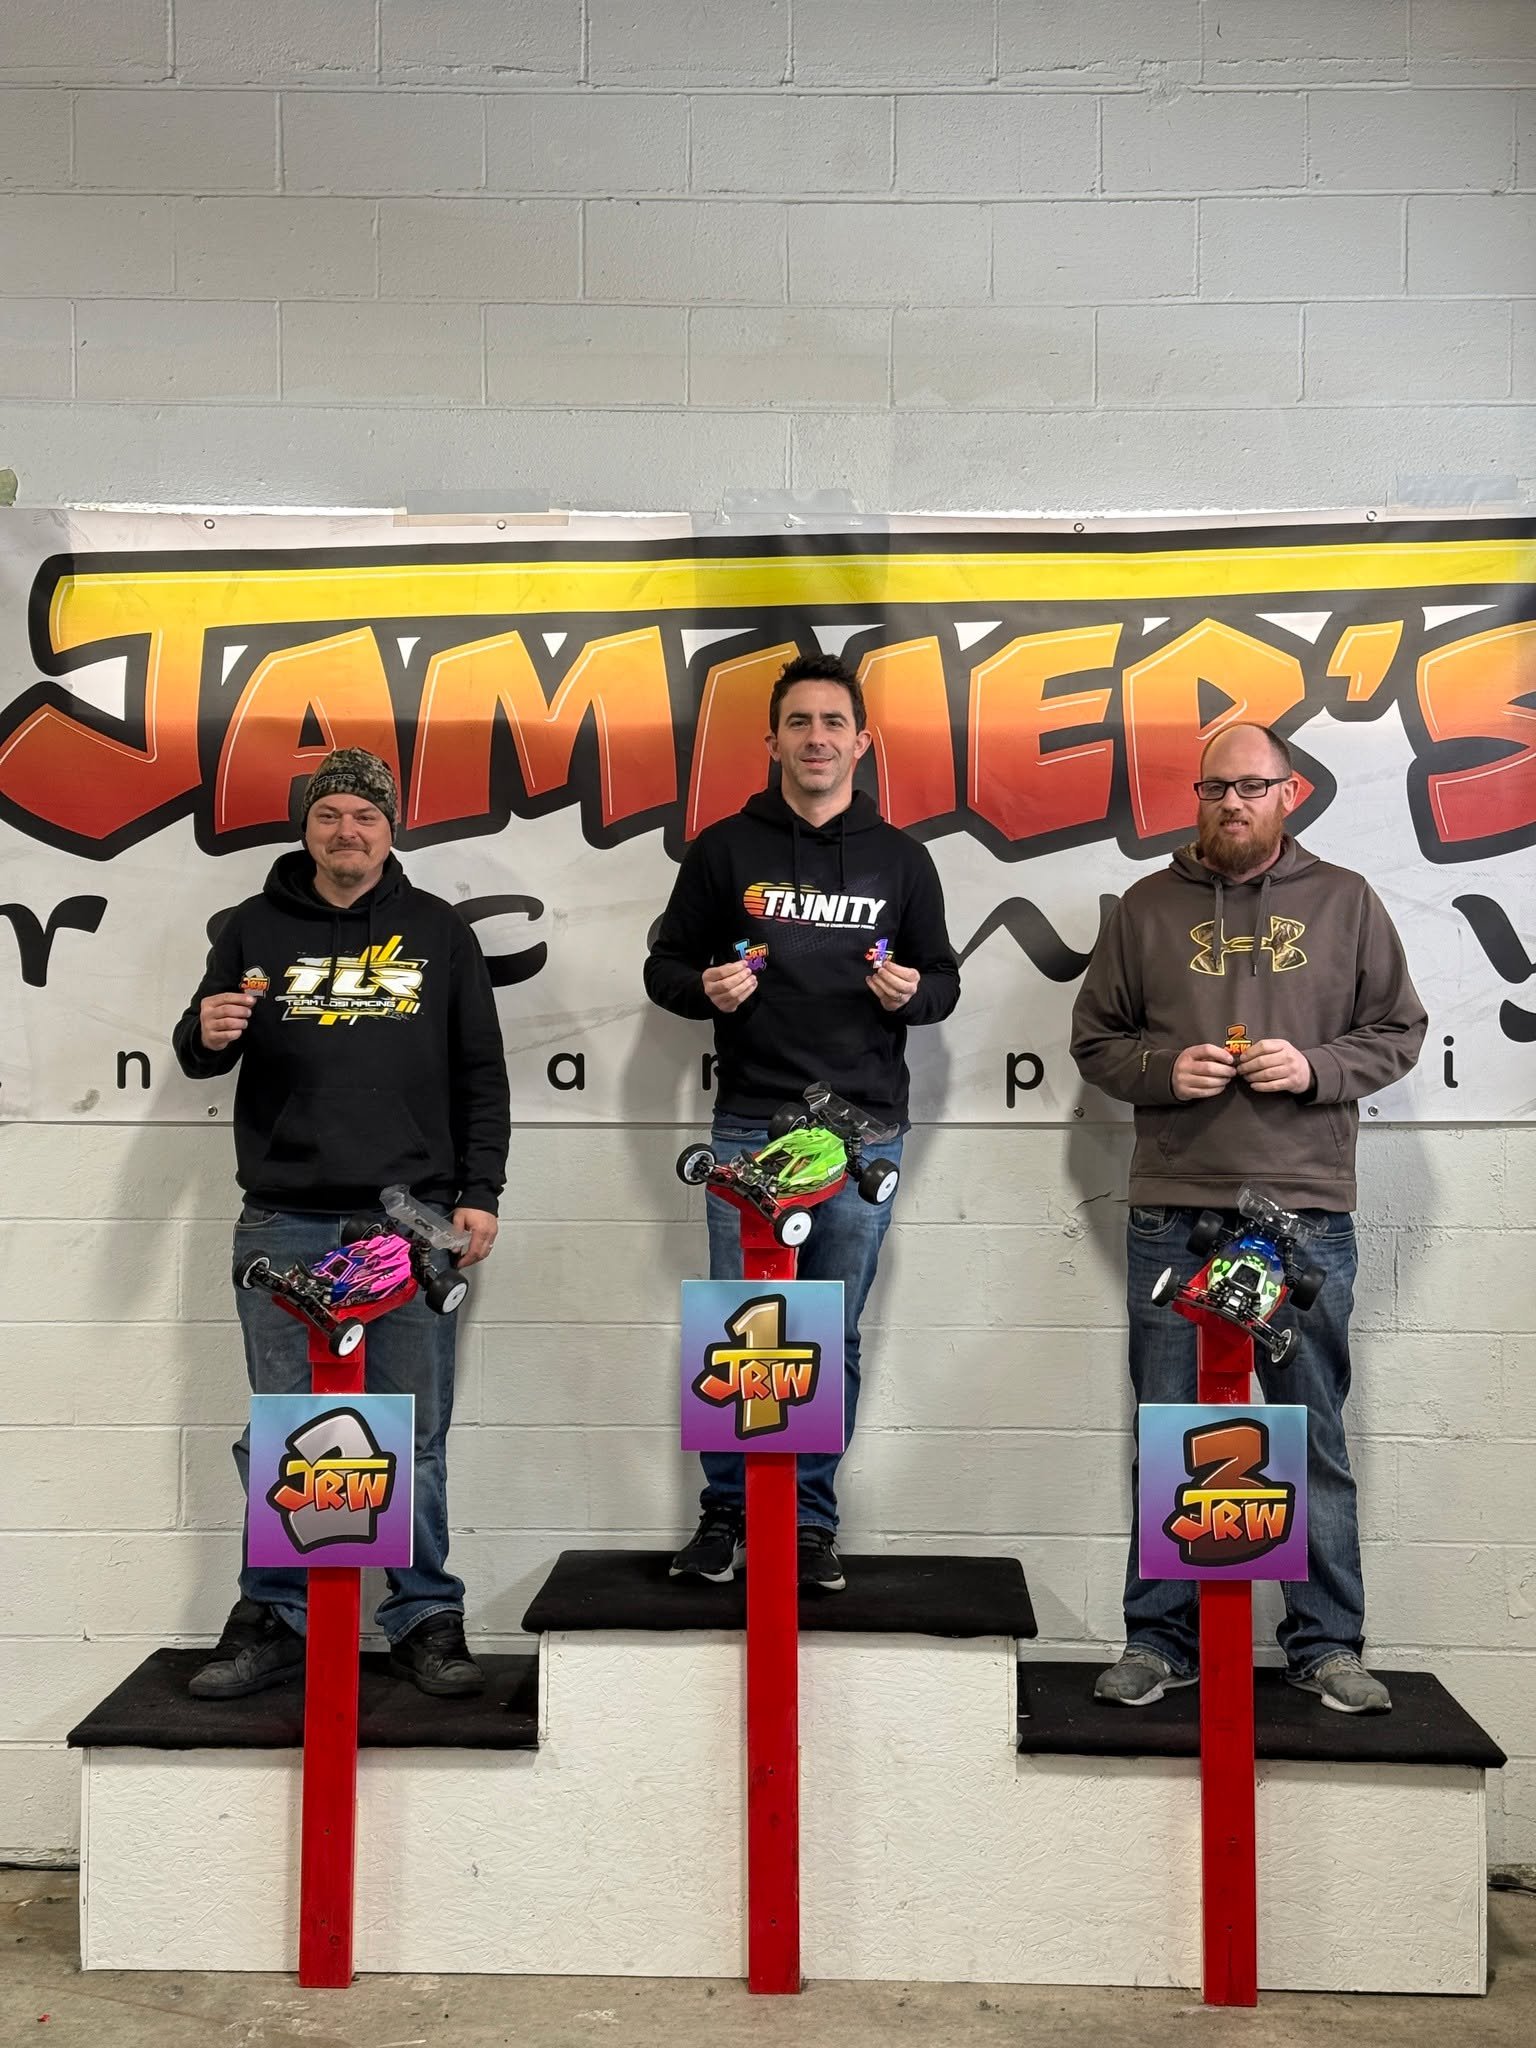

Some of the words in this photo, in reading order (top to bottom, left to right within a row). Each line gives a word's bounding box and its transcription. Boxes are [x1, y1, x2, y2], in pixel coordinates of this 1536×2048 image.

[0, 535, 1536, 860] JAMMER'S
[762, 890, 886, 924] TRINITY
[284, 966, 423, 1000] TLR
[321, 1000, 348, 1008] LOSI
[351, 1000, 396, 1008] RACING
[700, 1349, 814, 1401] JRW
[732, 1301, 781, 1433] 1
[273, 1458, 390, 1511] JRW
[1170, 1489, 1288, 1542] JRW
